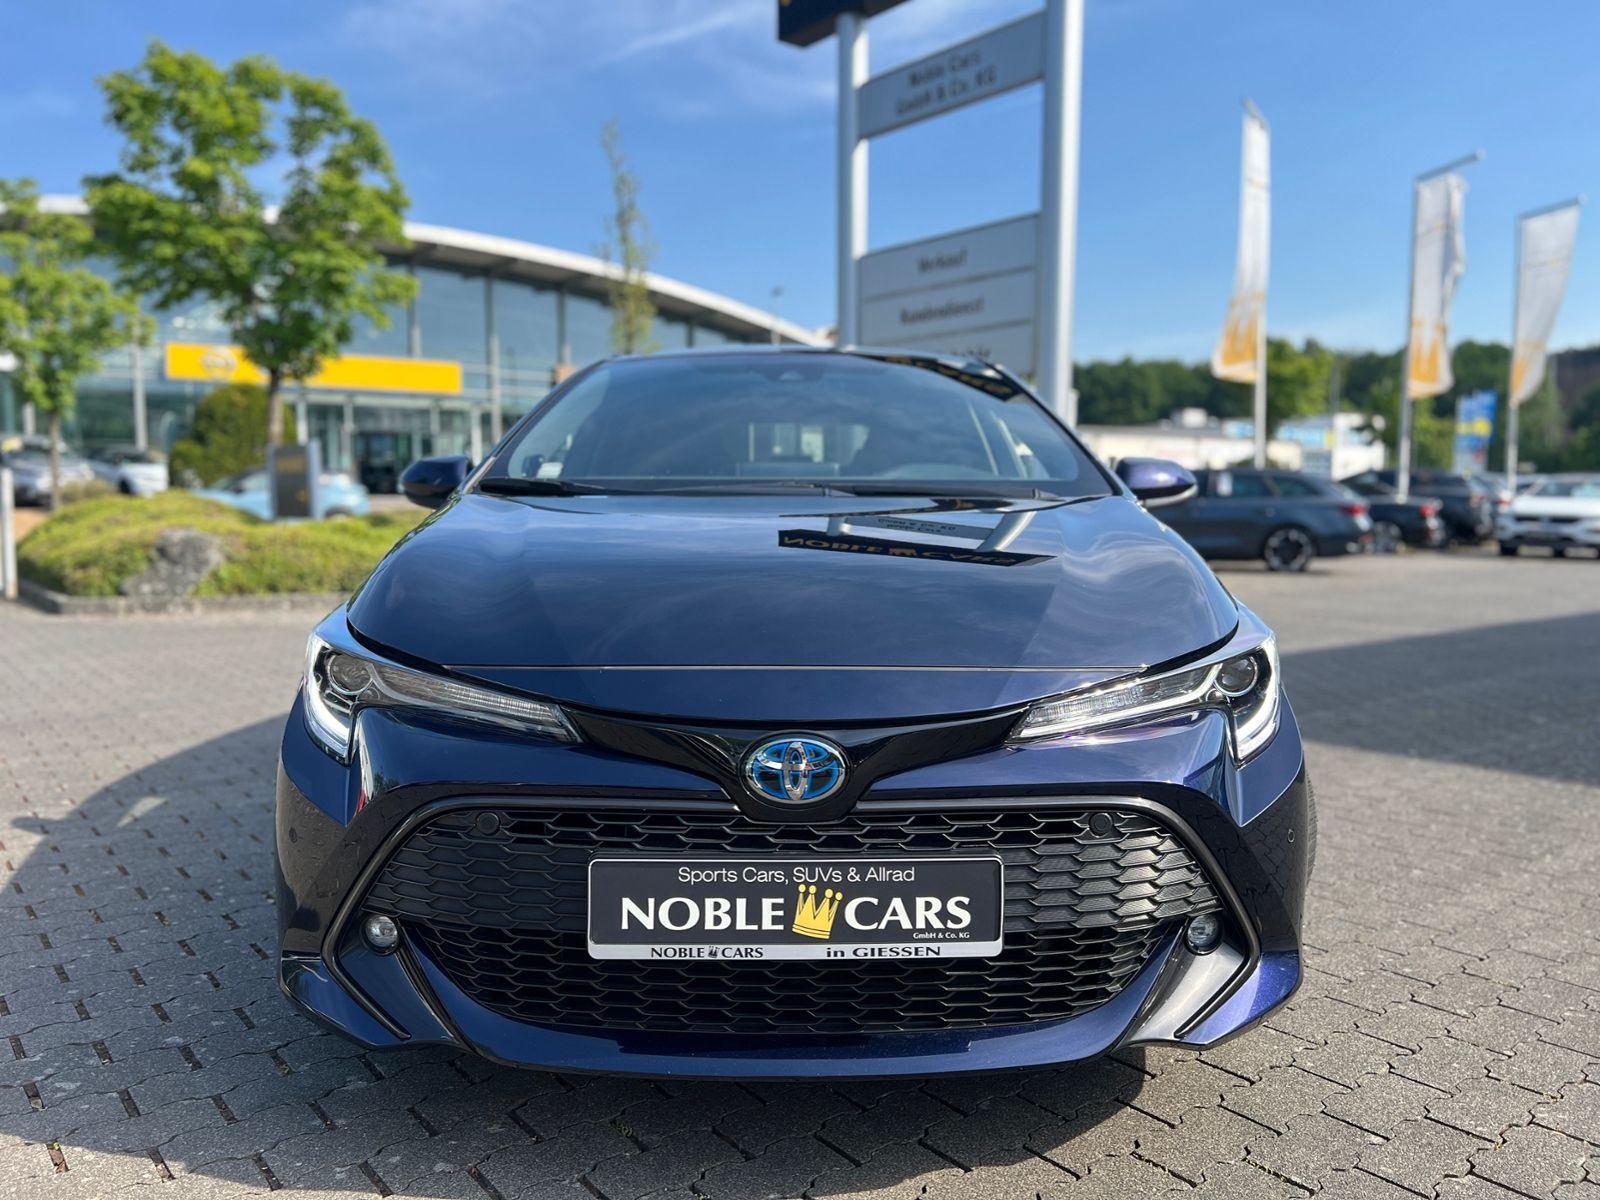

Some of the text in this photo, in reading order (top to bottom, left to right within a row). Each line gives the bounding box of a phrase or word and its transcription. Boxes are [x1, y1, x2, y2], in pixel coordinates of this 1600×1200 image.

[678, 866, 915, 885] Sports Cars, SUVs & Allrad
[621, 896, 972, 931] NOBLE CARS
[945, 931, 957, 939] Co.
[651, 946, 940, 959] NOBLE CARS in GIESSEN
